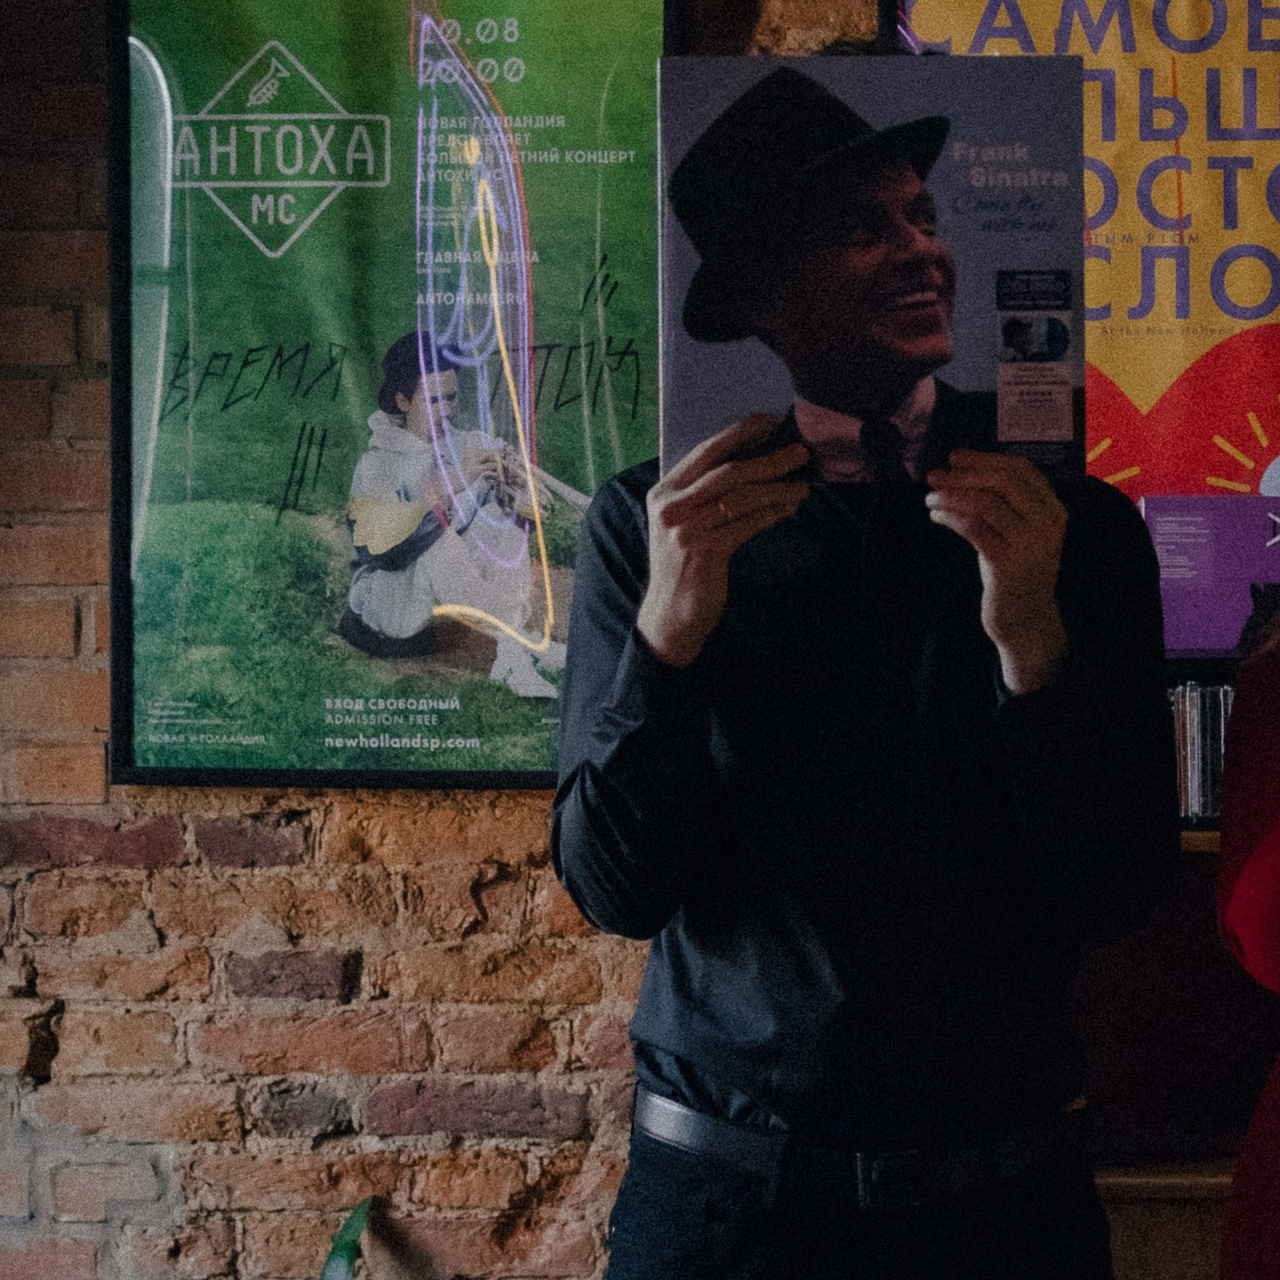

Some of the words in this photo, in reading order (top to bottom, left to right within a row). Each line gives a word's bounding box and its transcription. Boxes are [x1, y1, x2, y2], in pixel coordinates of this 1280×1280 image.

[174, 123, 376, 177] АНТОХА
[565, 149, 637, 164] КОНЦЕРТ
[952, 141, 1030, 163] Frank
[969, 166, 1069, 189] Sinatra
[159, 340, 348, 422] ВРЕМЯ
[325, 697, 364, 712] ВХОД
[368, 695, 461, 711] СВОБОДНЫЙ
[325, 714, 406, 726] ADMISSION
[409, 714, 439, 726] FREE
[325, 733, 481, 751] newhollandsp.com
